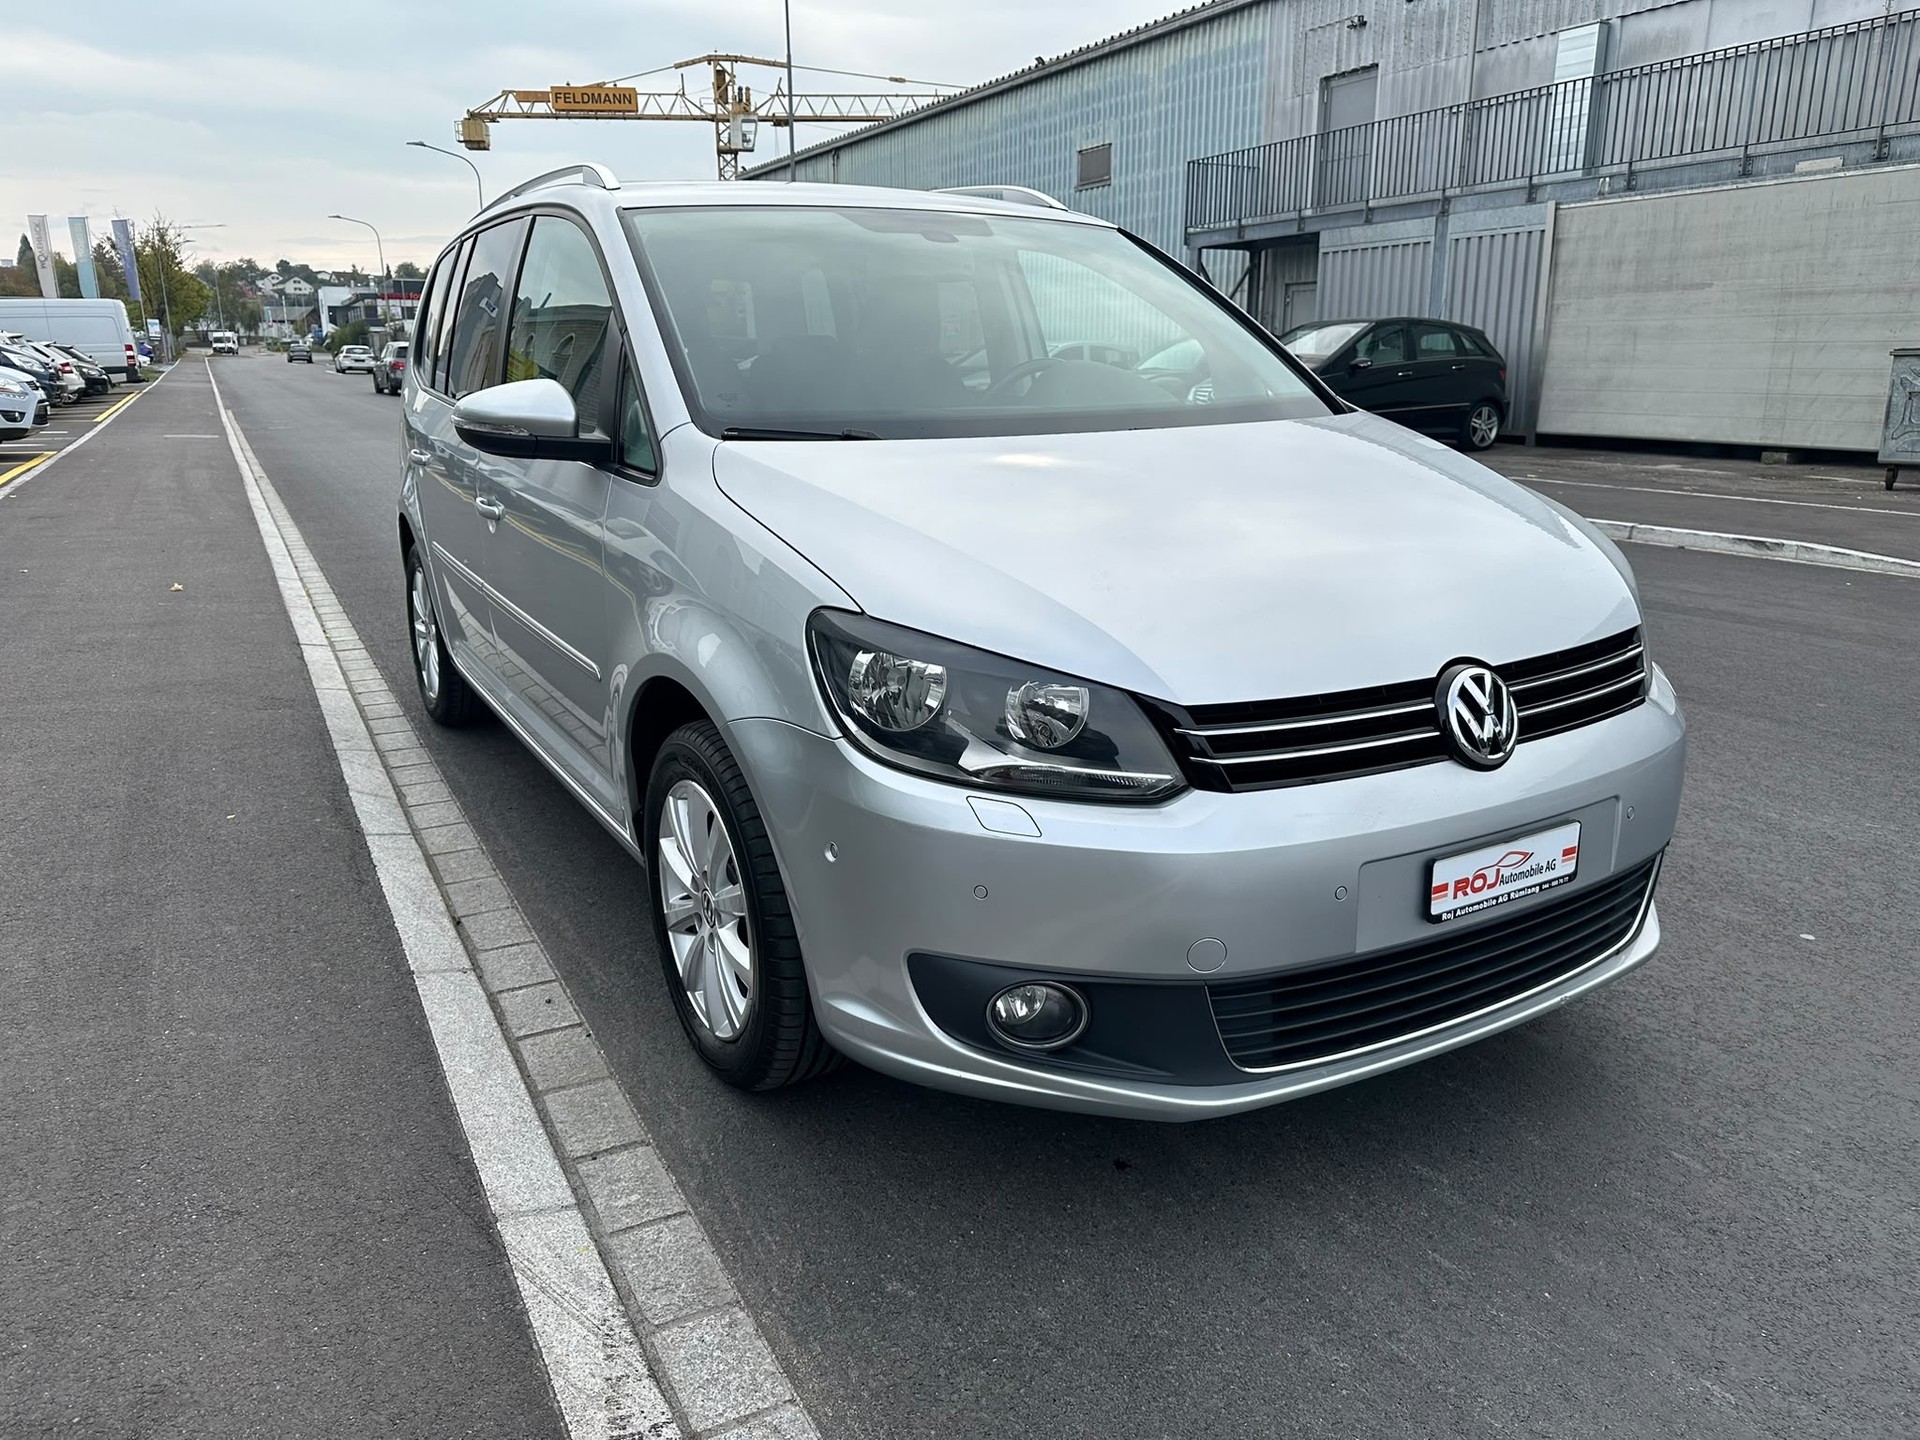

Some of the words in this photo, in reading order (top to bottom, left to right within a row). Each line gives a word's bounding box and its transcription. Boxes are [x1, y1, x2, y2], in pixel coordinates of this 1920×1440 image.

[554, 92, 632, 105] FELDMANN
[1453, 868, 1501, 900] ROJ
[1499, 862, 1544, 886] Automobile
[1544, 858, 1557, 873] AG
[1441, 910, 1454, 921] Roj
[1456, 898, 1497, 917] Automobile
[1497, 893, 1509, 904] AG
